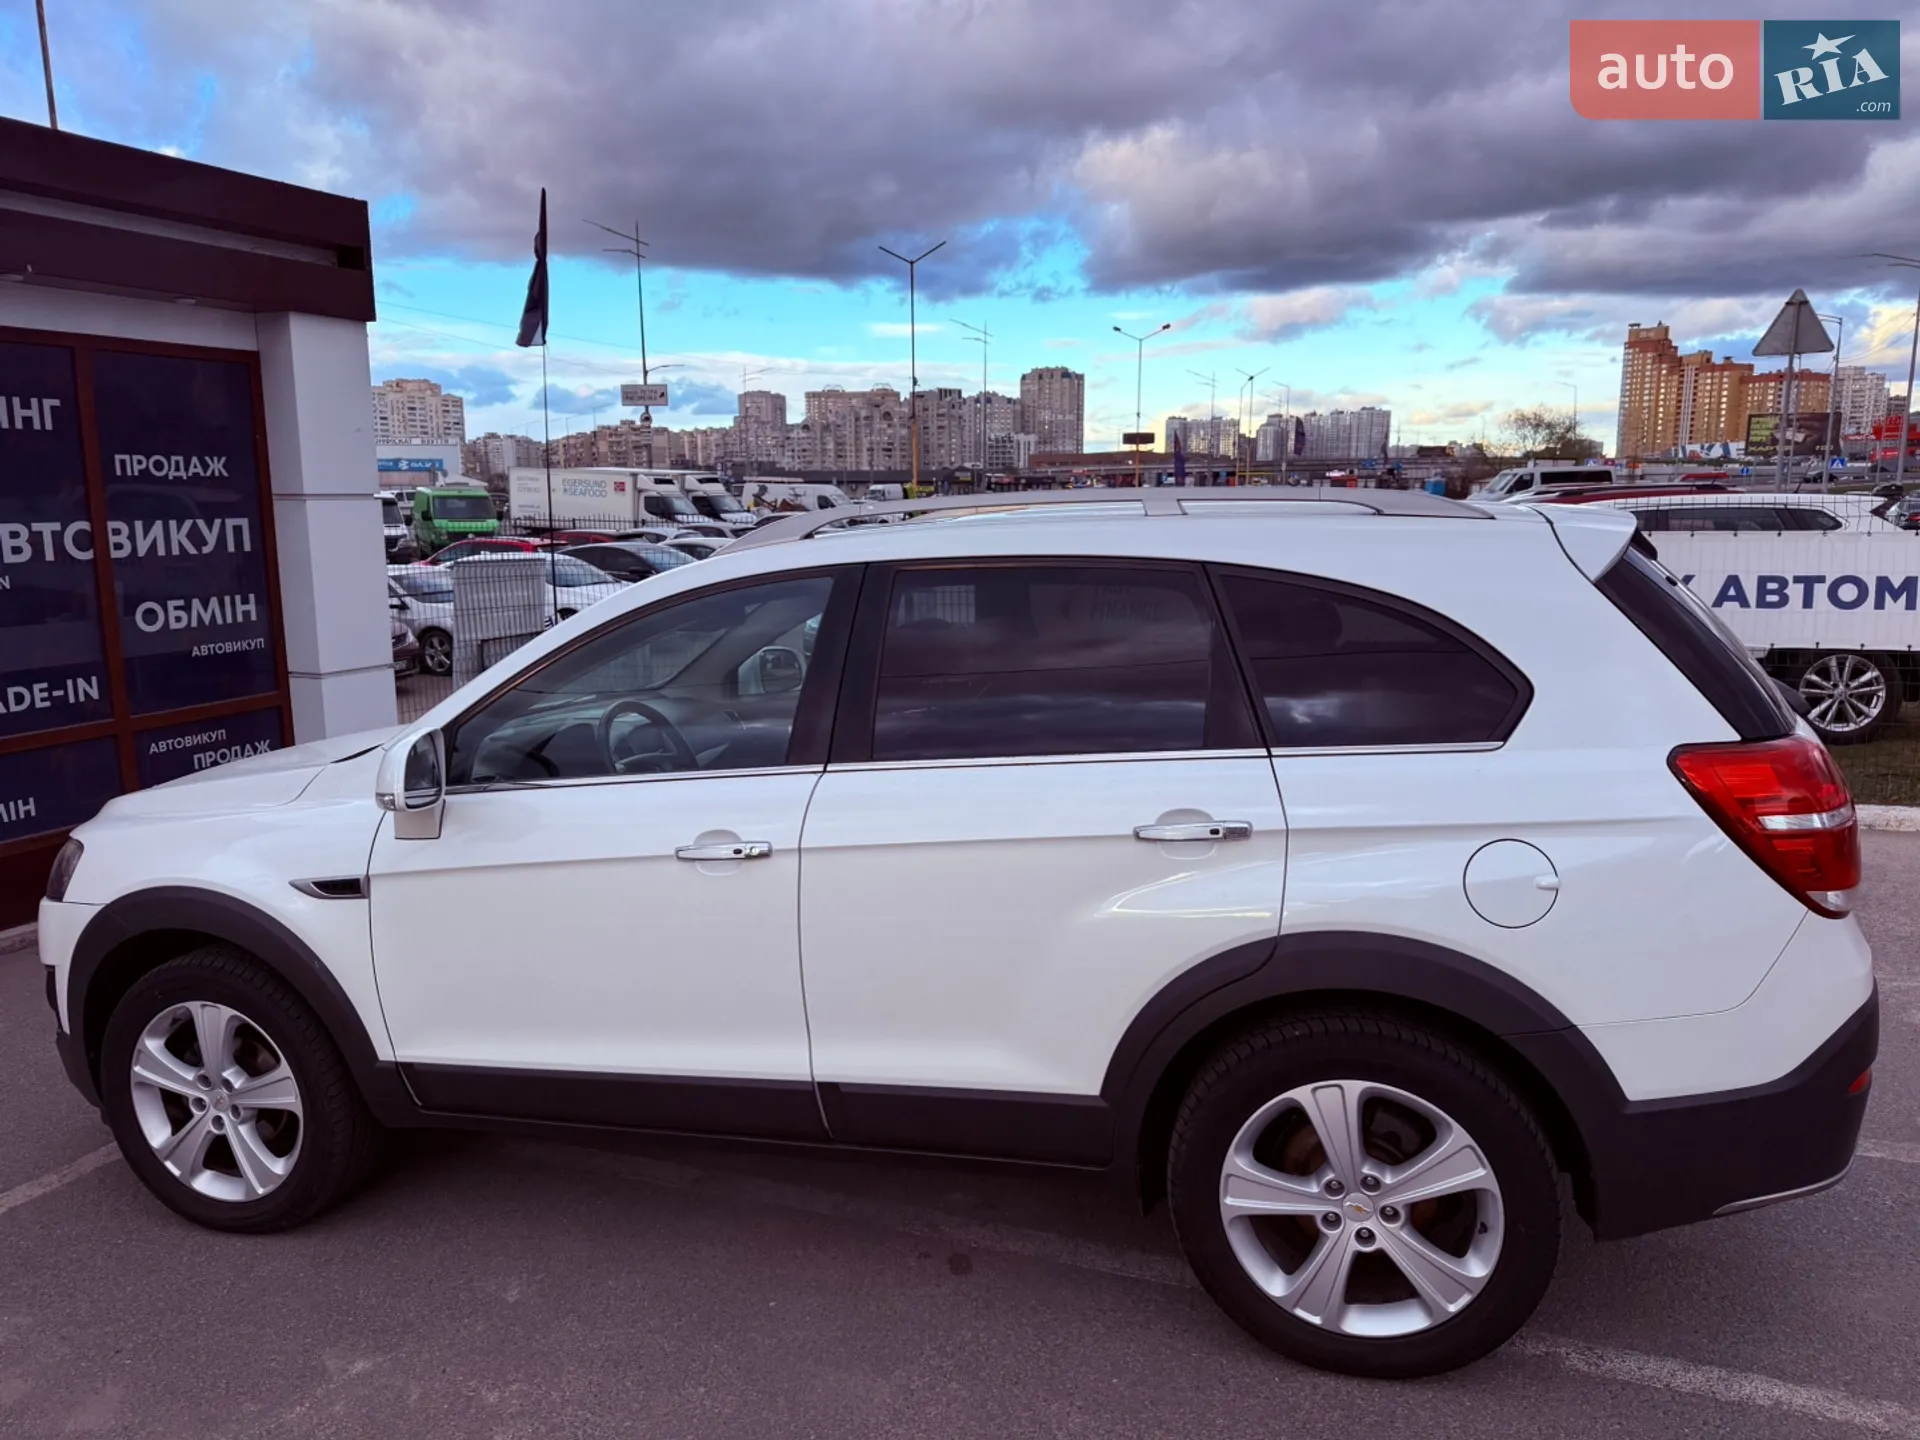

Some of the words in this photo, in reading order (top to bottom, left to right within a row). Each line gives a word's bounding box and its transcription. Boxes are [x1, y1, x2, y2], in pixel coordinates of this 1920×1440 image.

[114, 454, 229, 480] ПРОДАЖ
[562, 478, 607, 489] EGERSUND
[1711, 574, 1919, 610] АВТОМ
[135, 593, 258, 632] ОБМІН
[191, 638, 265, 657] АВТОВИКУП
[149, 729, 226, 755] АВТОВИКУП
[193, 739, 271, 770] ПРОДАЖ
